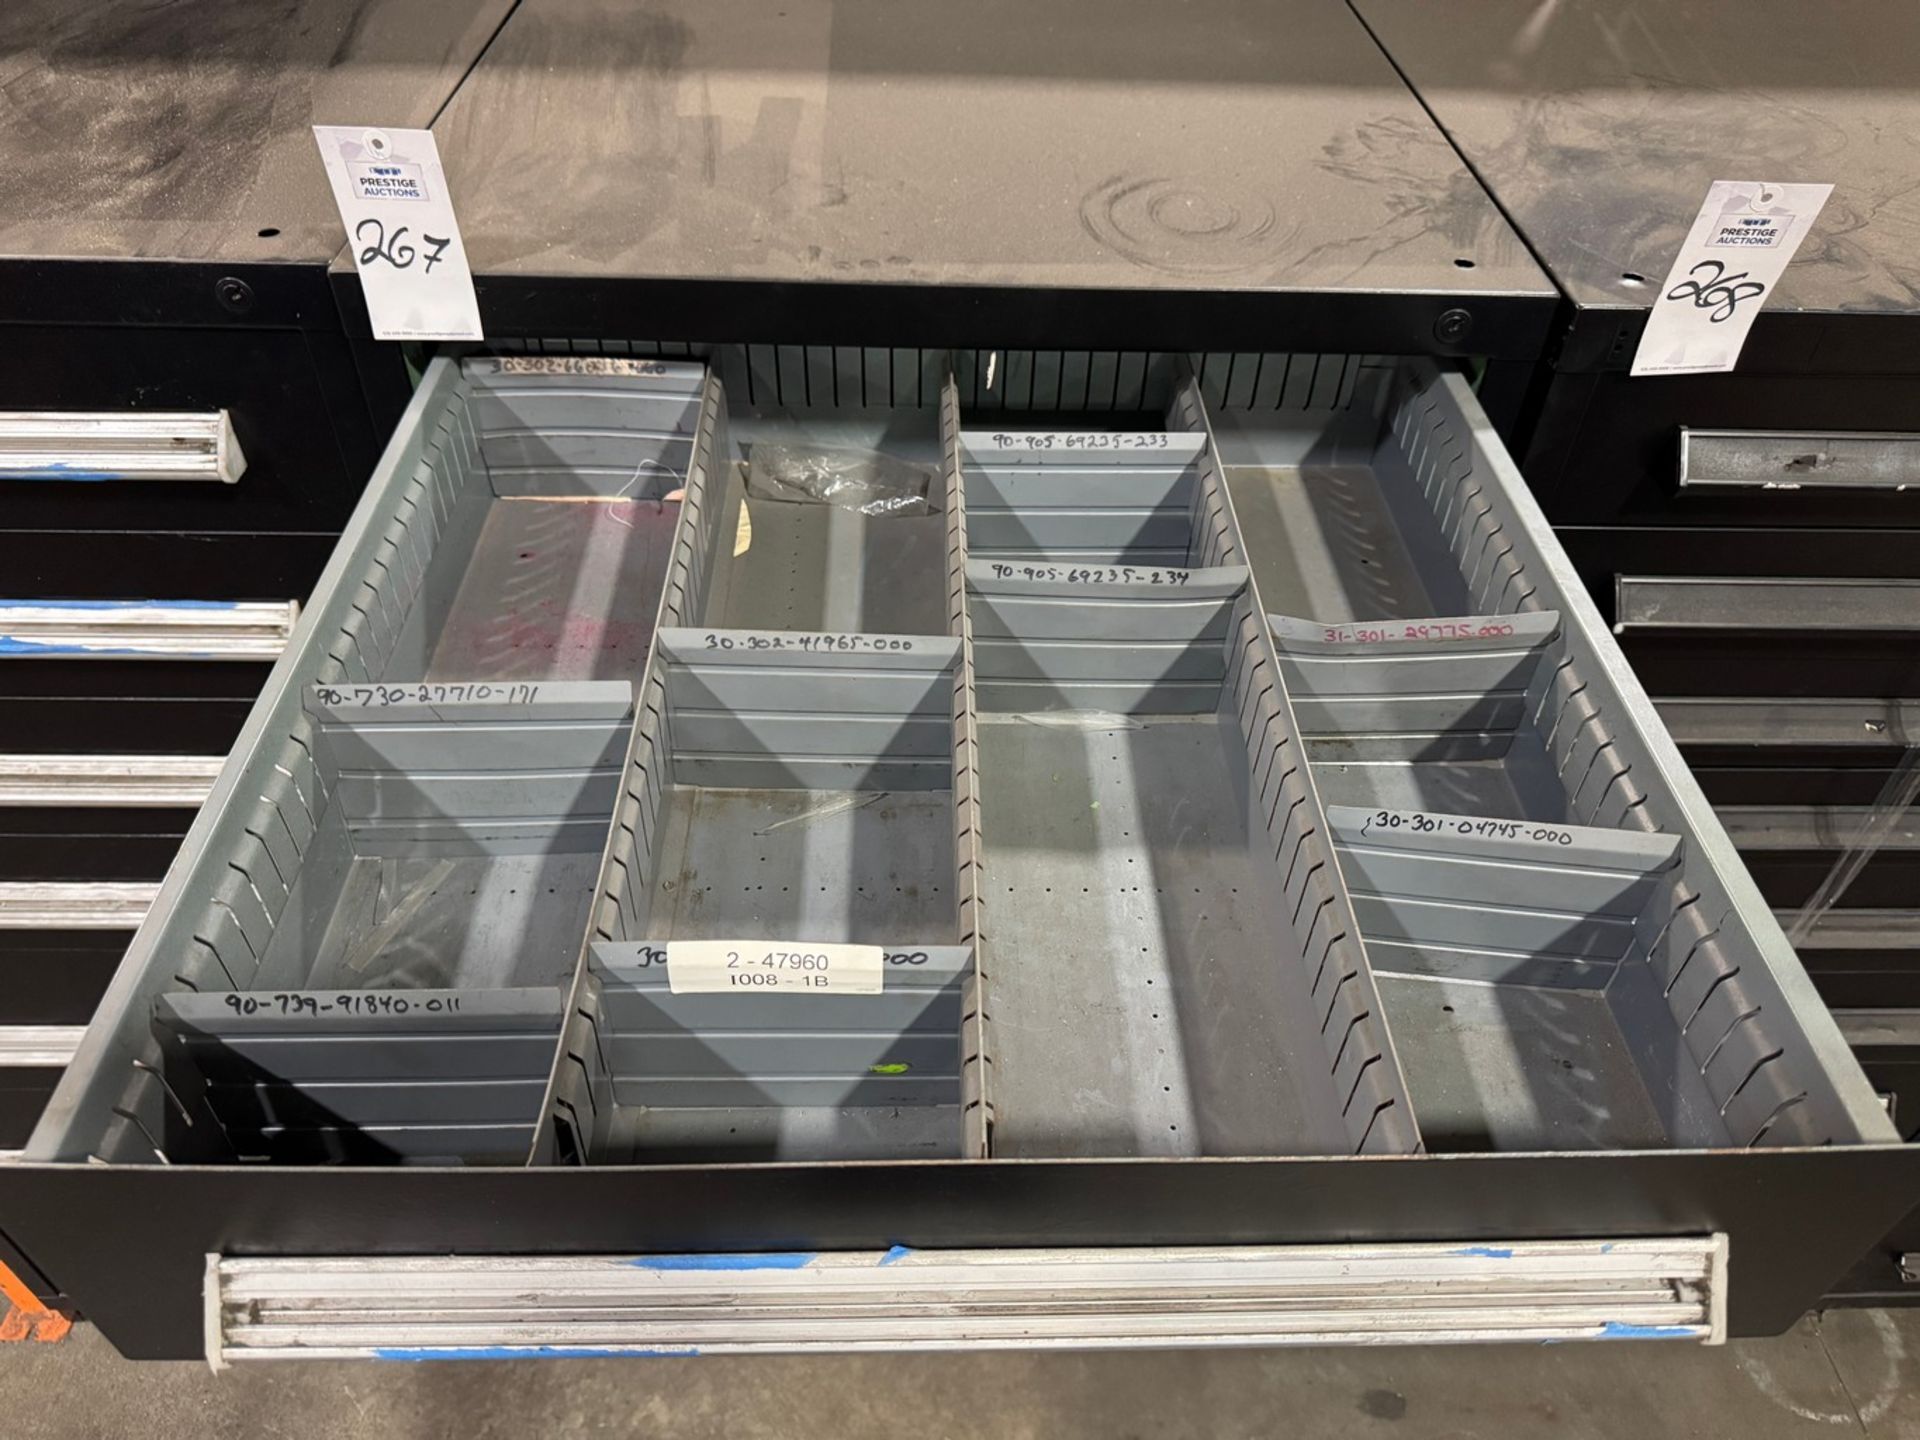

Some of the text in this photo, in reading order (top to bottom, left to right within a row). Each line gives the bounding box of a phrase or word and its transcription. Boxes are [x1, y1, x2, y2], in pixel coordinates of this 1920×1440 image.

[360, 177, 417, 188] PRESTIGE
[364, 187, 420, 198] AUCTIONS
[1719, 228, 1778, 237] PRESTIGE
[356, 218, 451, 274] 267
[1716, 236, 1773, 245] AUCTIONS
[1666, 260, 1765, 323] 268
[727, 951, 740, 968] 2
[761, 952, 829, 971] 47960
[802, 975, 829, 987] 1B
